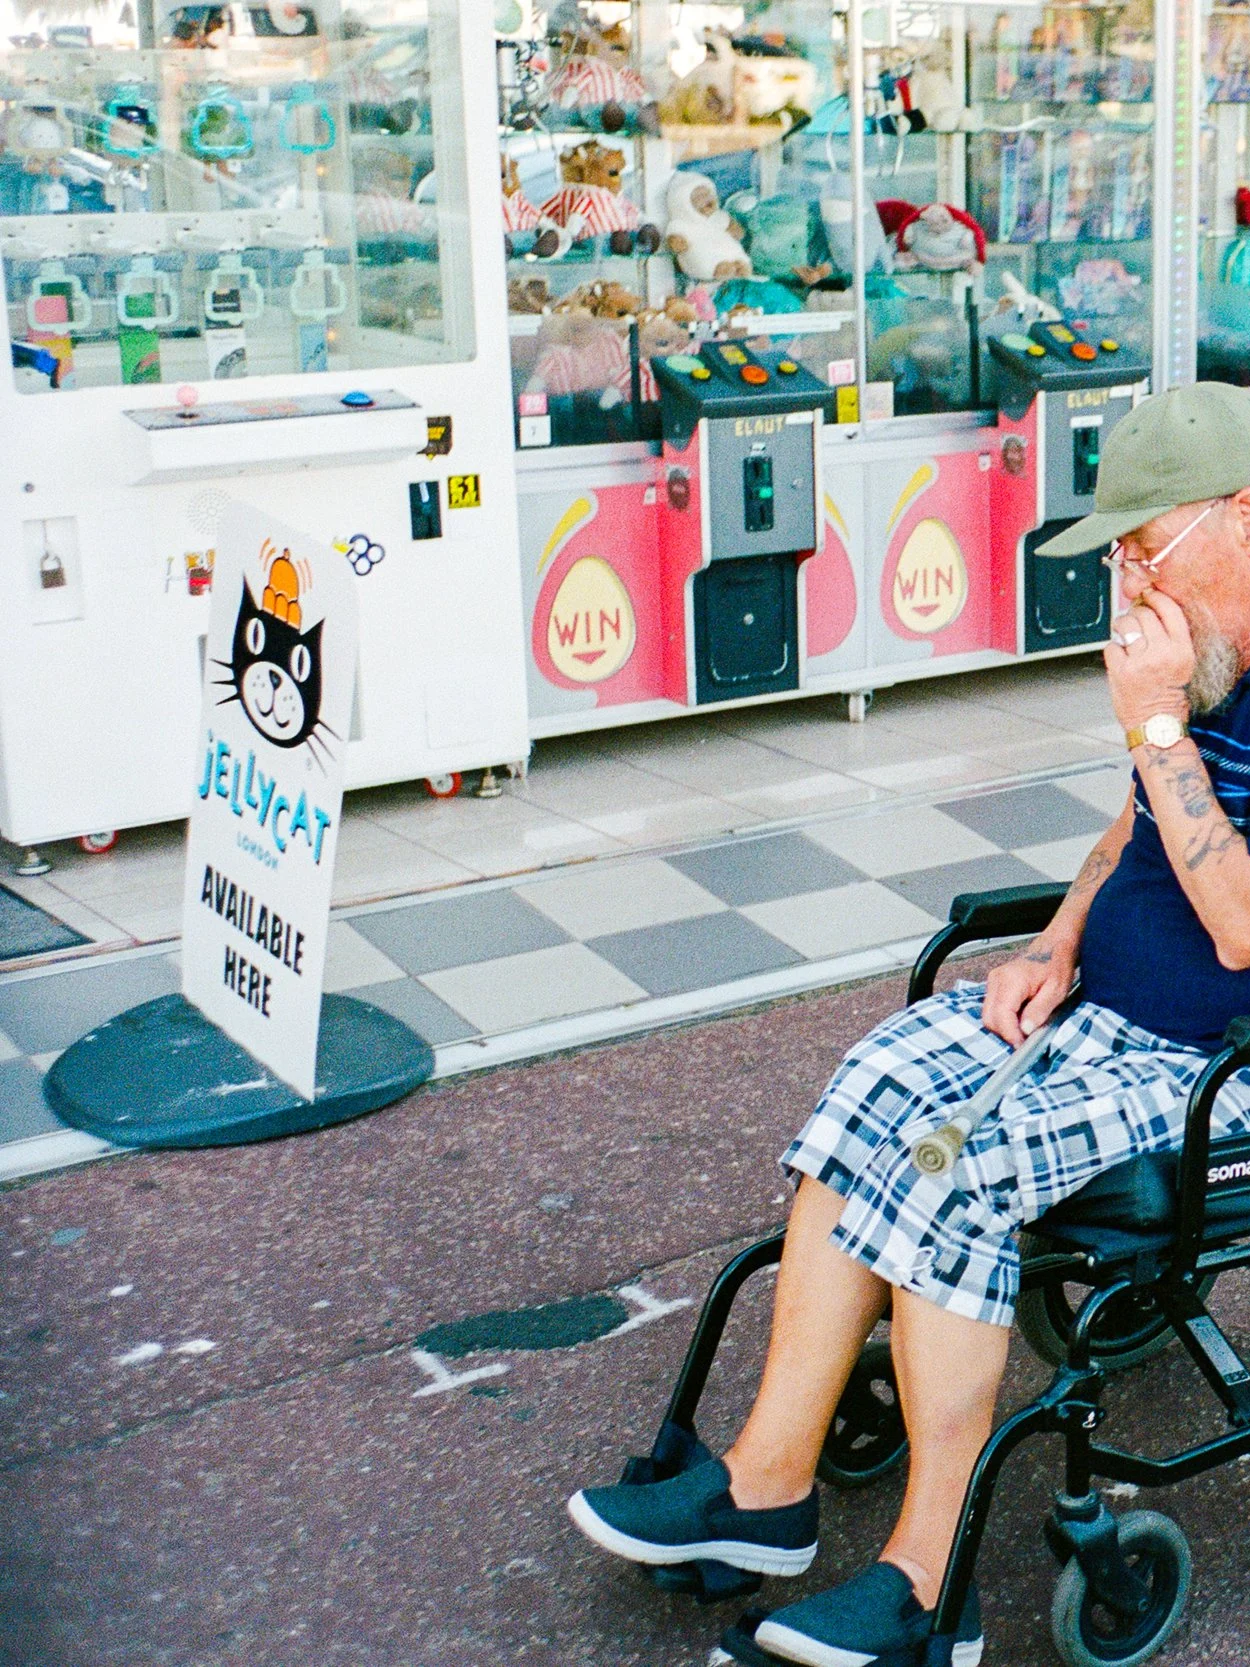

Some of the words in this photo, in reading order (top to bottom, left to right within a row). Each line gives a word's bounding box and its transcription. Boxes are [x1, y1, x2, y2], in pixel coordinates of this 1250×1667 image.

[735, 415, 787, 437] ELAUT
[896, 564, 954, 601] WIN
[553, 607, 622, 648] WIN
[236, 831, 279, 870] LONDON
[201, 863, 305, 977] AVAILABLE
[223, 944, 273, 1019] HERE
